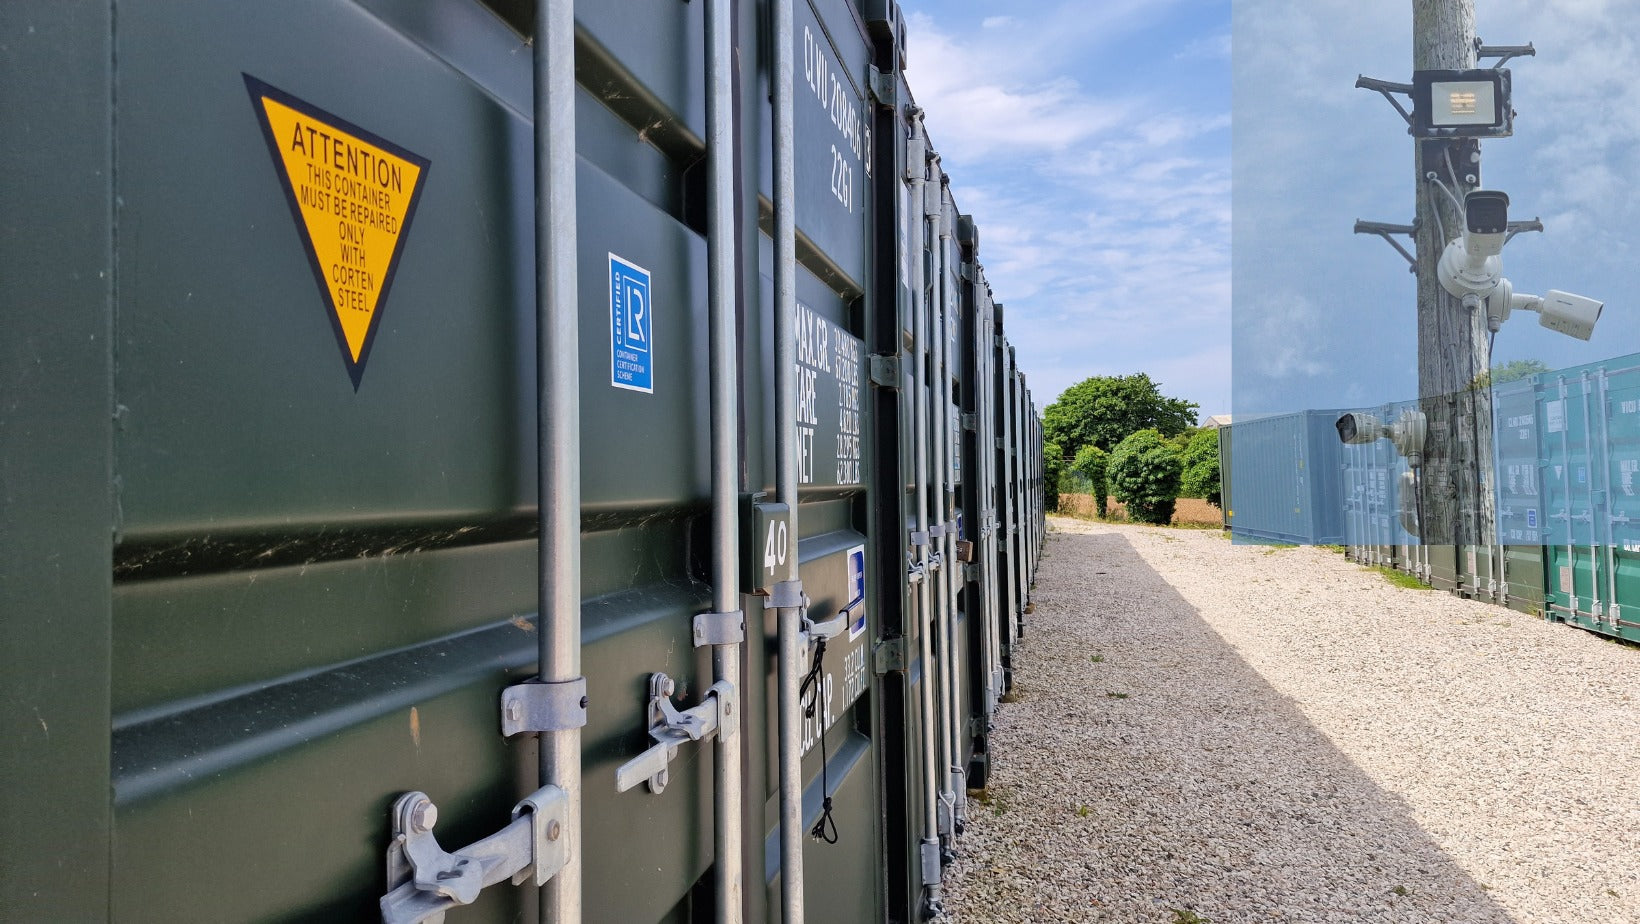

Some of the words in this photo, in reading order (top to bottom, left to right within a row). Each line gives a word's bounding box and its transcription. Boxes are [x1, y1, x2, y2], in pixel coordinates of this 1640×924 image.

[804, 25, 828, 109] CLVU
[830, 72, 861, 161] 208406
[292, 122, 402, 194] ATTENTION
[307, 163, 332, 190] THIS
[335, 174, 391, 212] CONTAINER
[301, 184, 331, 214] MUST
[334, 196, 348, 219] BE
[351, 201, 398, 235] REPAIRED
[339, 221, 365, 246] ONLY
[340, 243, 366, 268] WITH
[332, 264, 374, 291] CORTEN
[338, 288, 370, 313] STEEL
[617, 350, 638, 361] CONTAINER
[617, 361, 645, 374] CERTIFICATION
[617, 371, 633, 381] SCHEME
[796, 365, 817, 425] TARE
[796, 427, 814, 484] NET
[764, 519, 787, 576] 40
